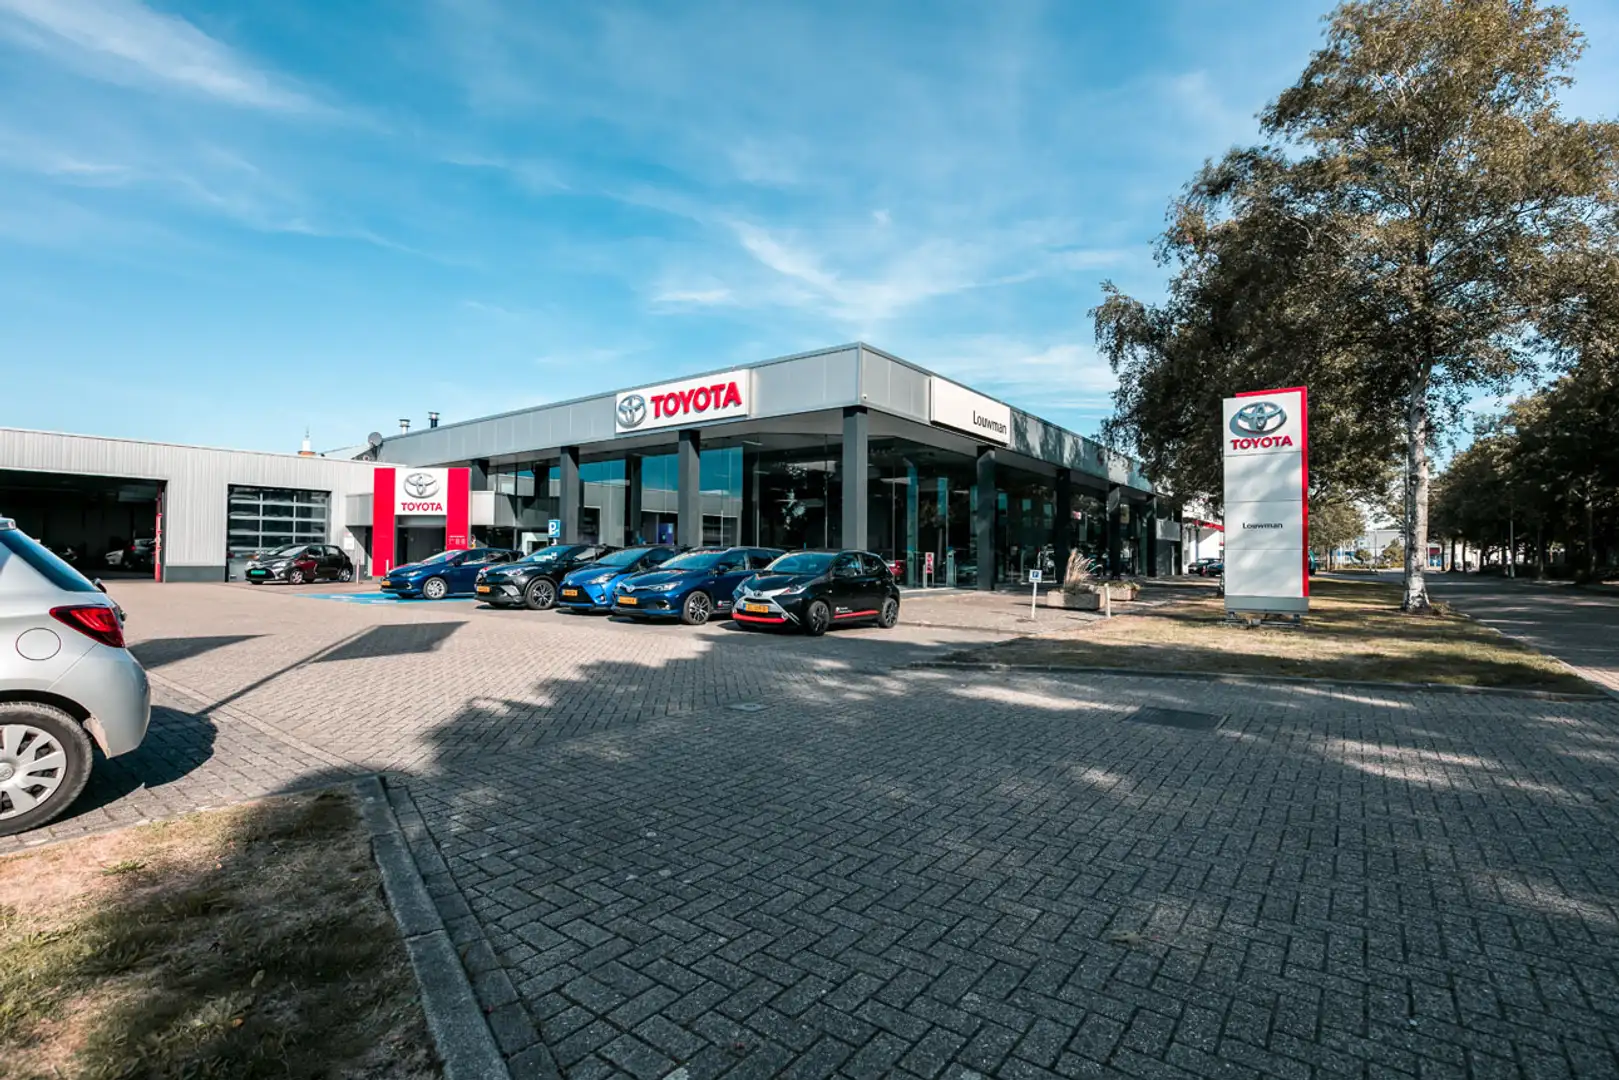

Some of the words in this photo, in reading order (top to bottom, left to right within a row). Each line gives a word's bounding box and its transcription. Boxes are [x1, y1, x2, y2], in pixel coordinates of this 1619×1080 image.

[651, 381, 742, 419] TOYOTA
[973, 409, 1007, 435] Louwman
[1230, 435, 1293, 450] TOYOTA
[401, 502, 443, 511] TOYOTA
[1242, 522, 1283, 530] Louwman
